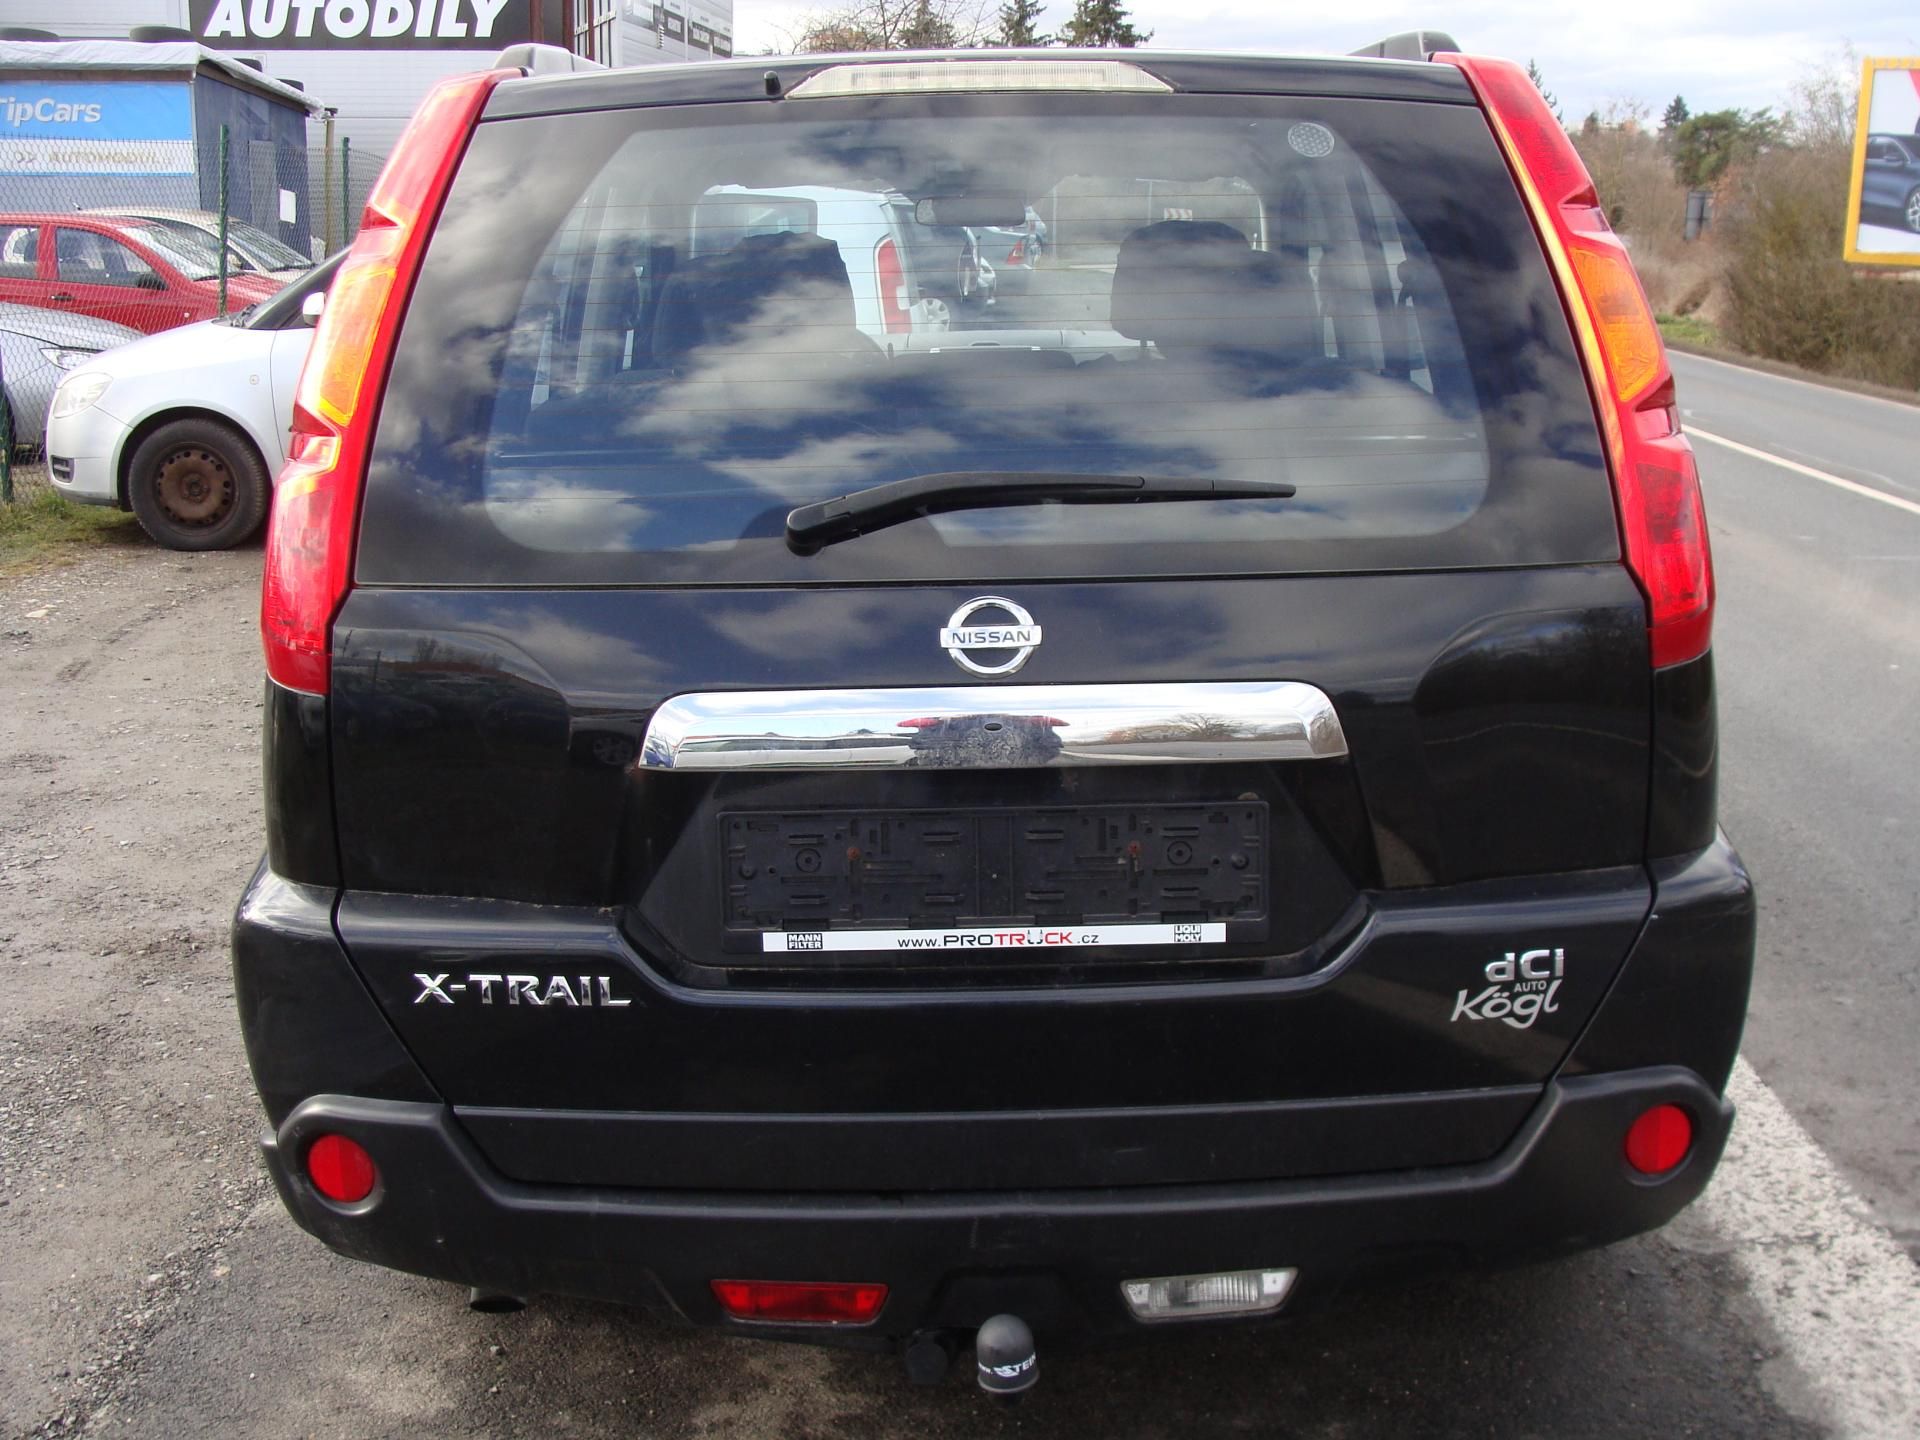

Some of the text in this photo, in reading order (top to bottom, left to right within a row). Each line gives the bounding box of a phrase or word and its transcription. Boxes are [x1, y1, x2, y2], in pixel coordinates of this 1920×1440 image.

[952, 630, 1031, 644] NISSAN
[788, 934, 822, 942] MANN
[1175, 934, 1201, 942] MOLY
[788, 941, 822, 949] FILTER
[414, 973, 632, 1006] X-TRAIL
[1514, 980, 1547, 993] AUTO
[1450, 979, 1563, 1029] Kögl
